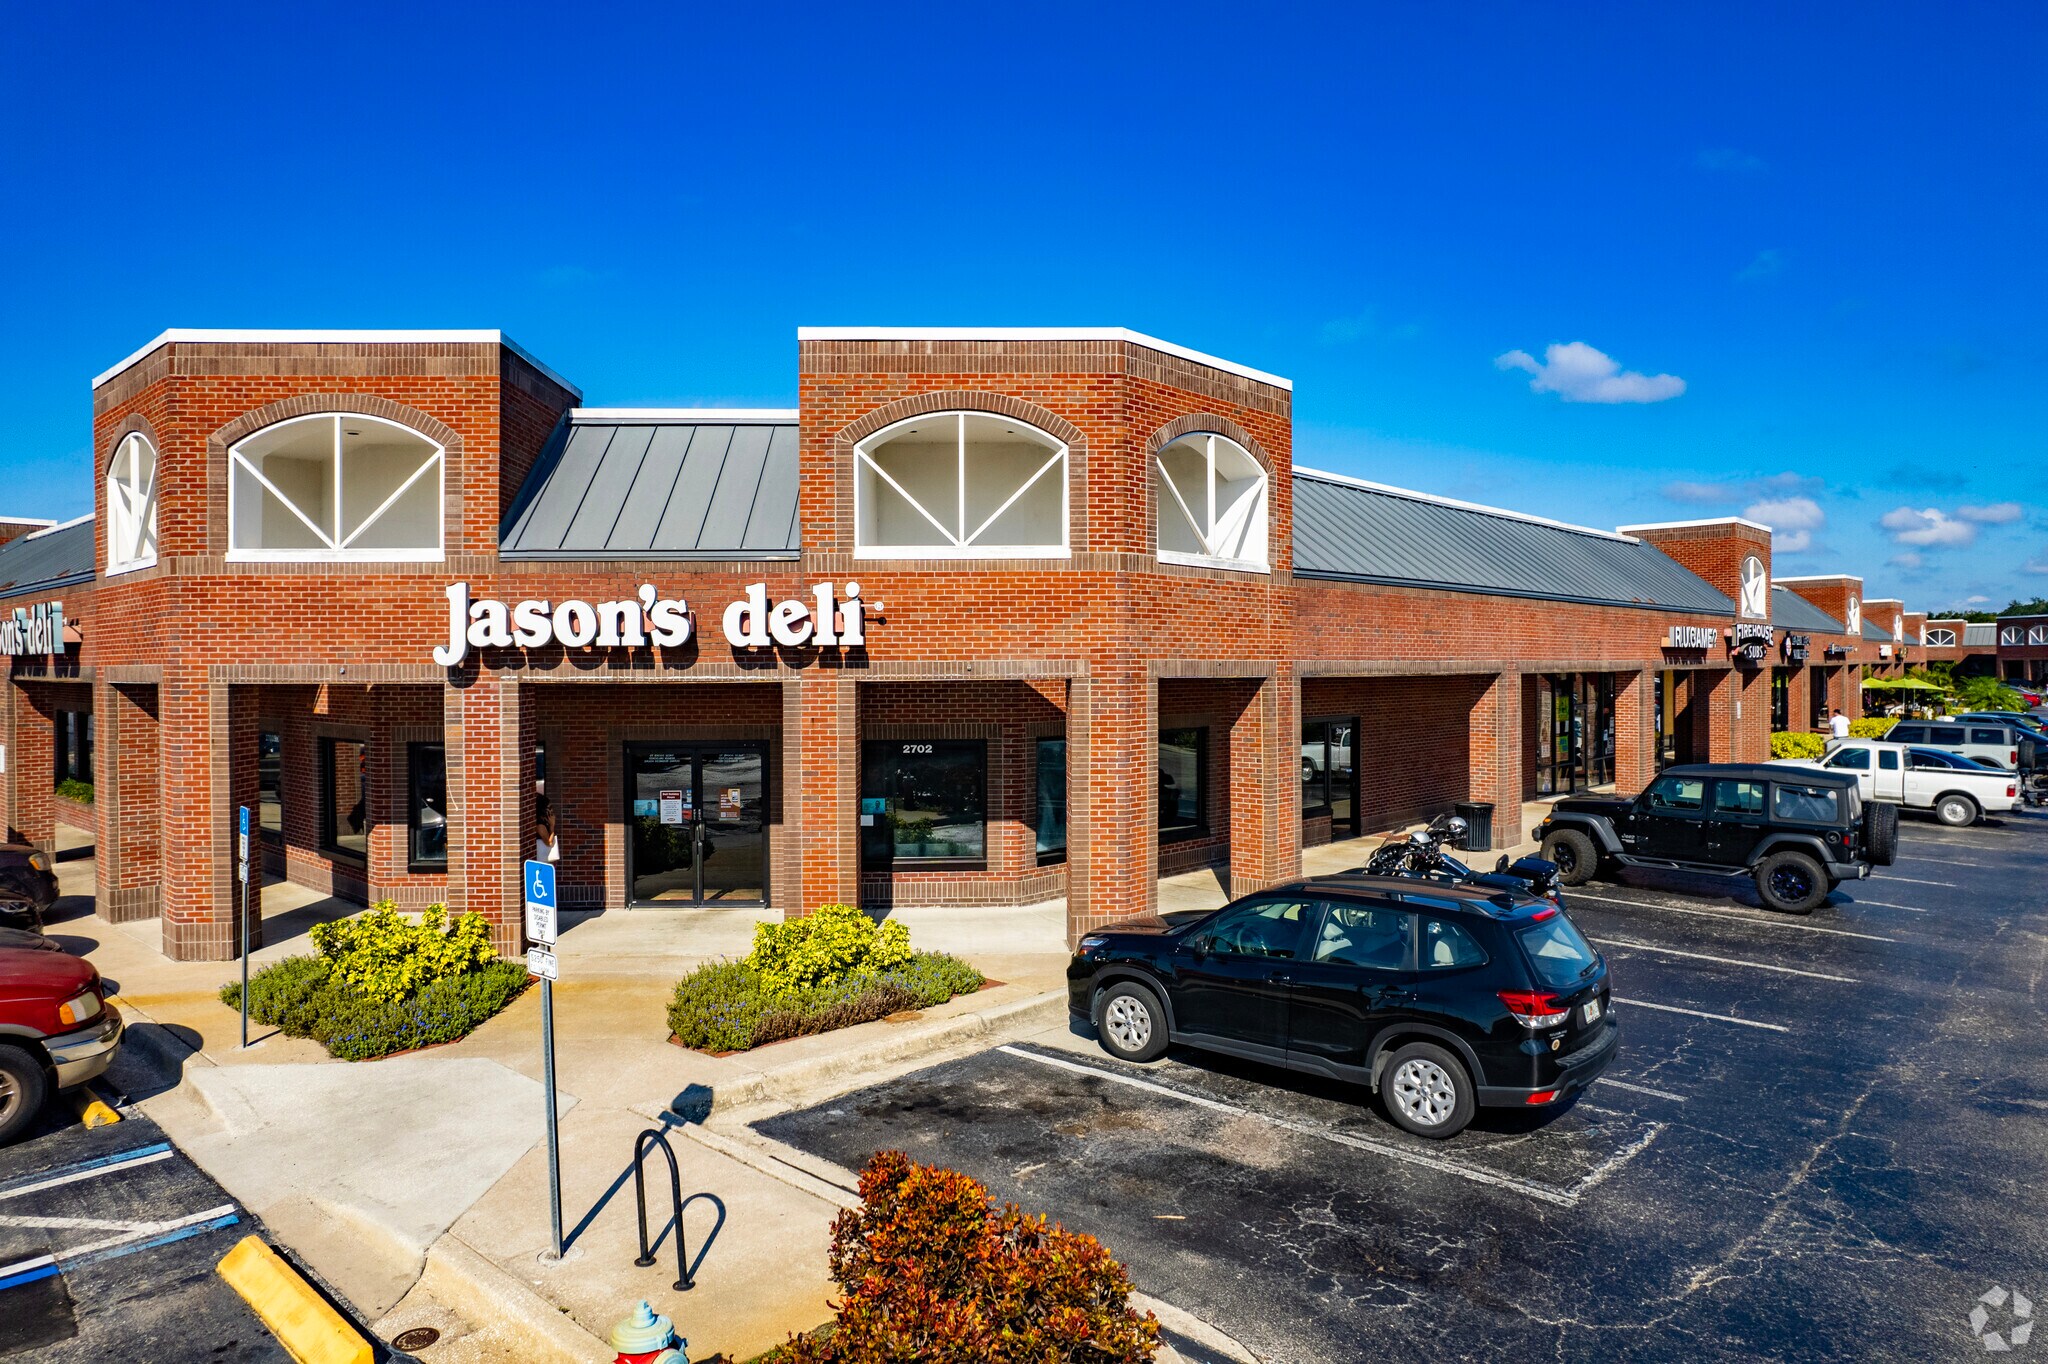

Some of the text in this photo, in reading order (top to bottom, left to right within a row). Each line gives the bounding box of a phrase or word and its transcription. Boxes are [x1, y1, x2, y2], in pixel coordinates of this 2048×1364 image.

[722, 581, 866, 647] deli
[0, 601, 53, 656] on's deli
[1736, 623, 1773, 647] FIREHOUSE
[1748, 645, 1763, 658] SUBS
[902, 744, 932, 754] 2702
